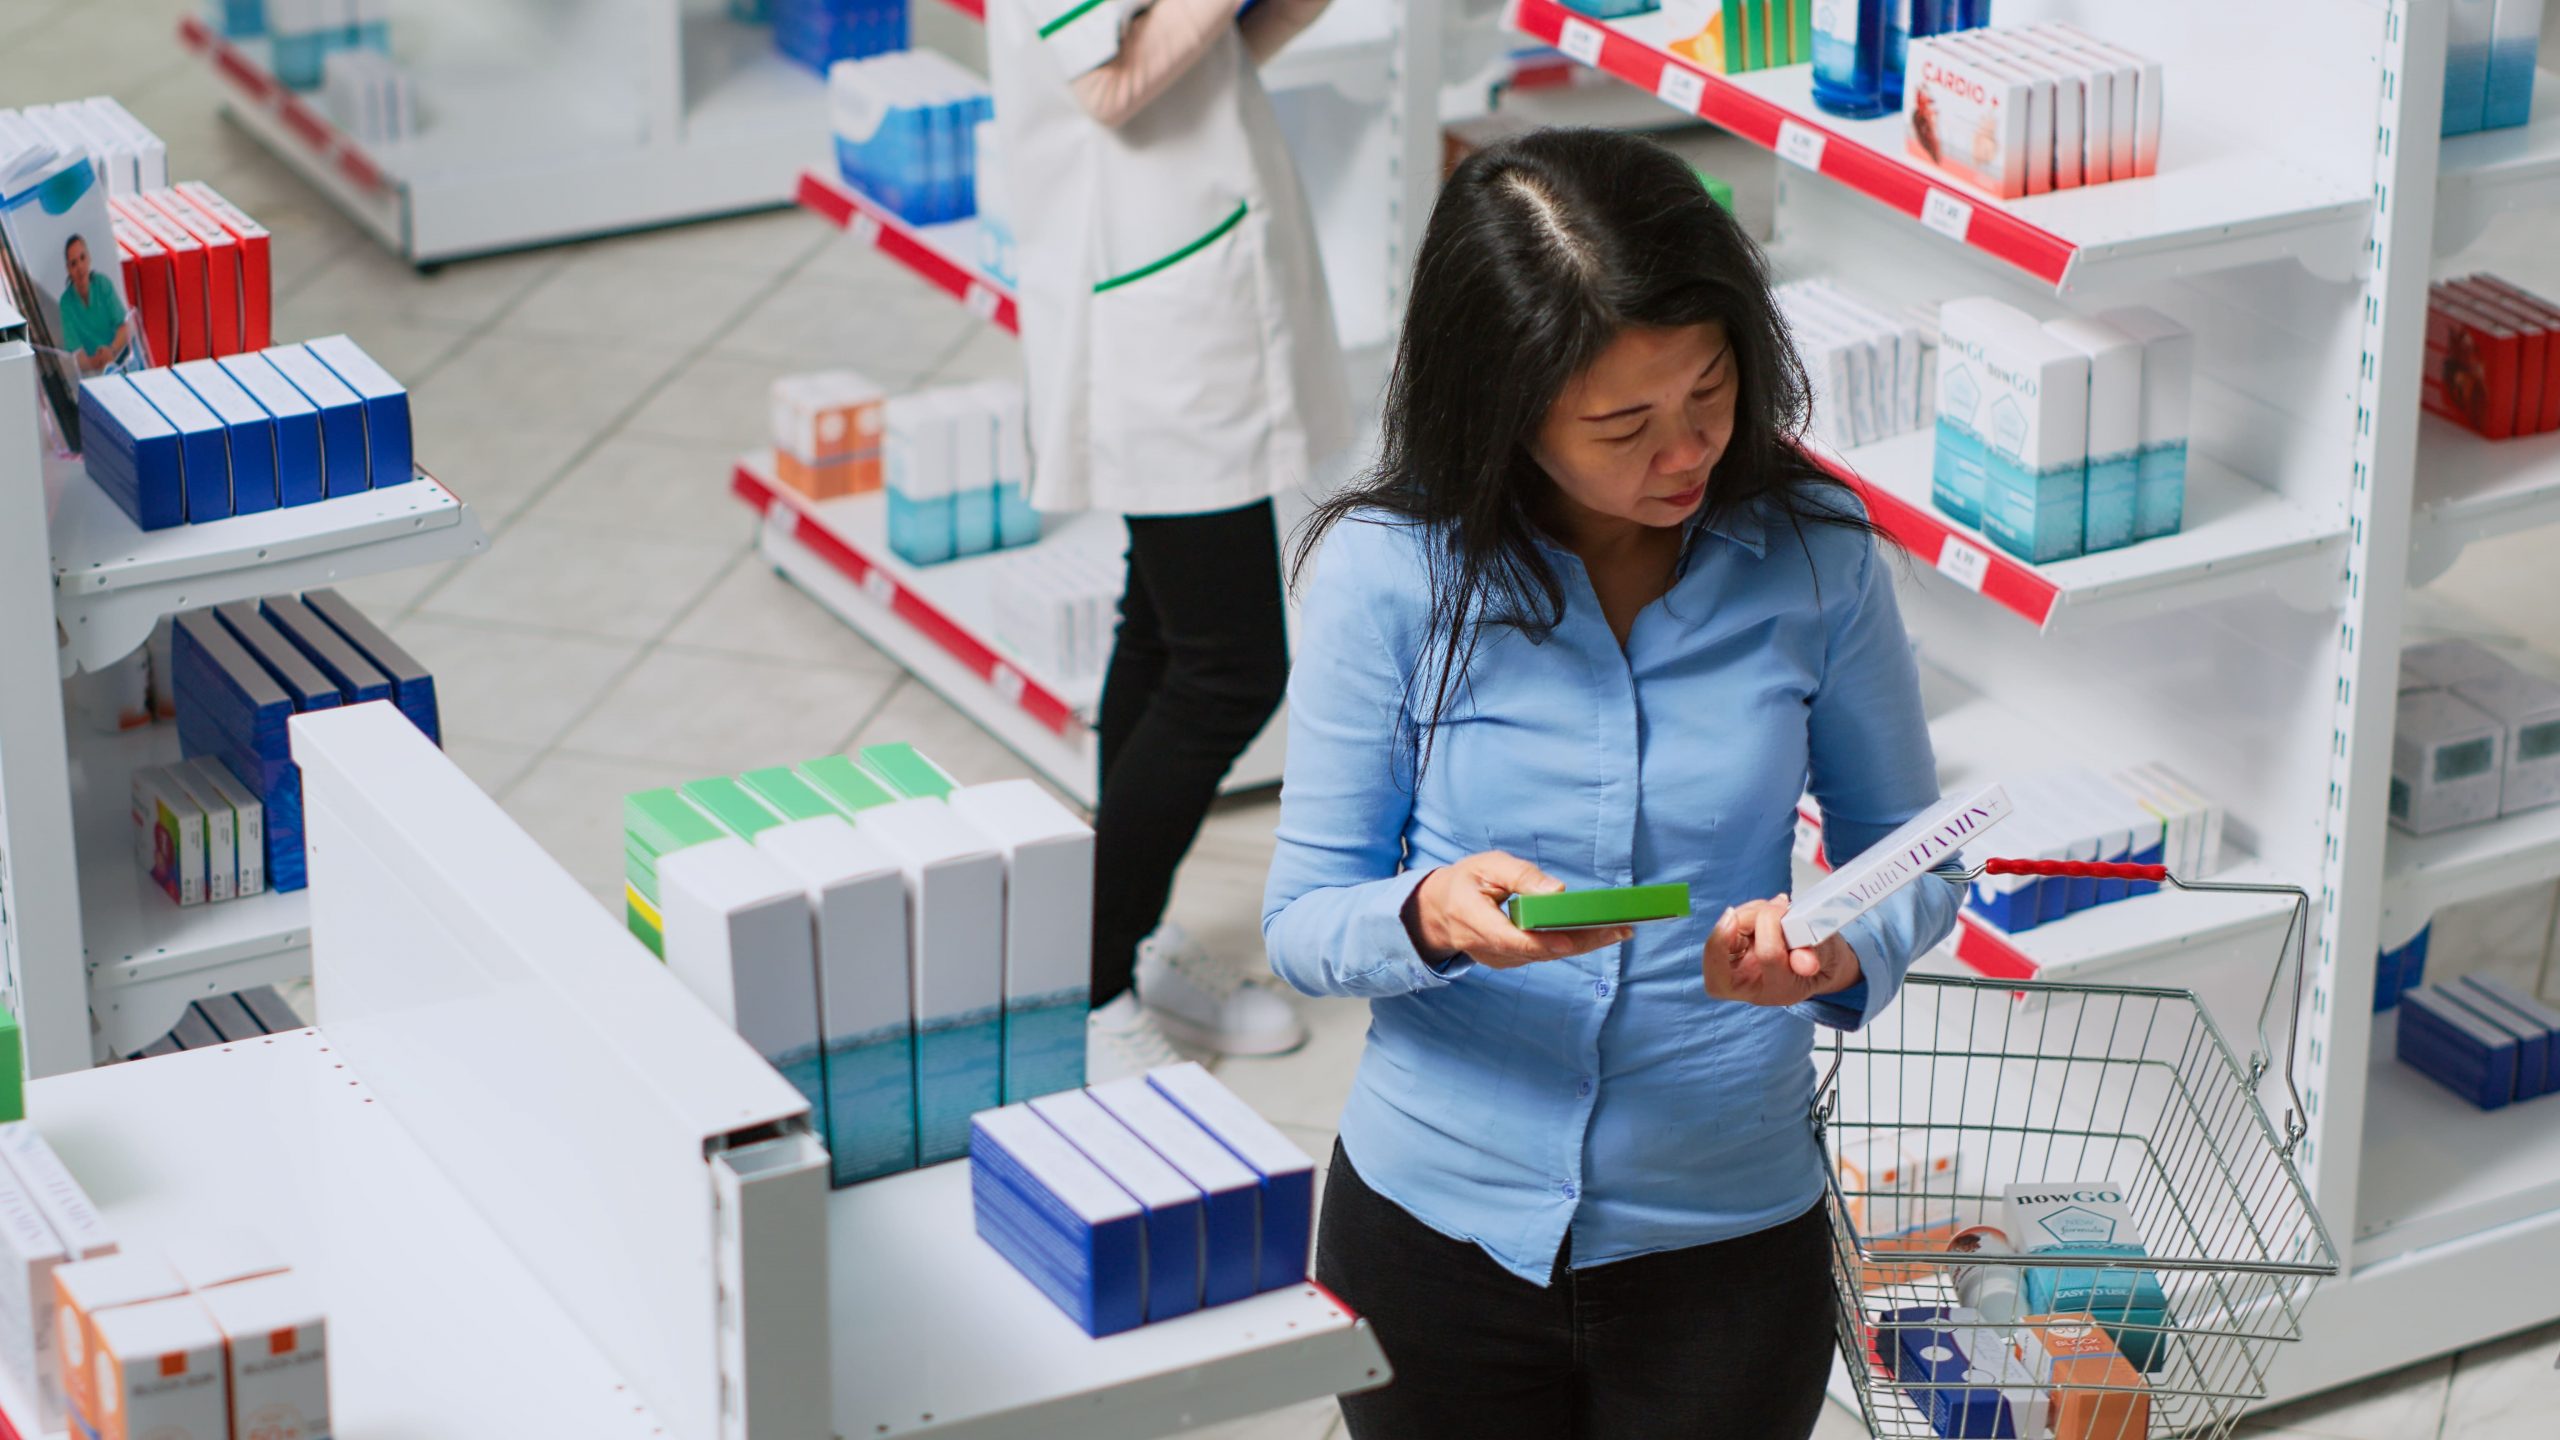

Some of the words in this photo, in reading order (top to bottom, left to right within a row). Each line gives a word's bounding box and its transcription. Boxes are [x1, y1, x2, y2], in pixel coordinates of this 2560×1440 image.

[1922, 61, 1985, 106] CARDIO
[1986, 362, 2037, 399] nowGO
[2016, 1190, 2121, 1206] nowGO
[2056, 1288, 2084, 1299] EASY
